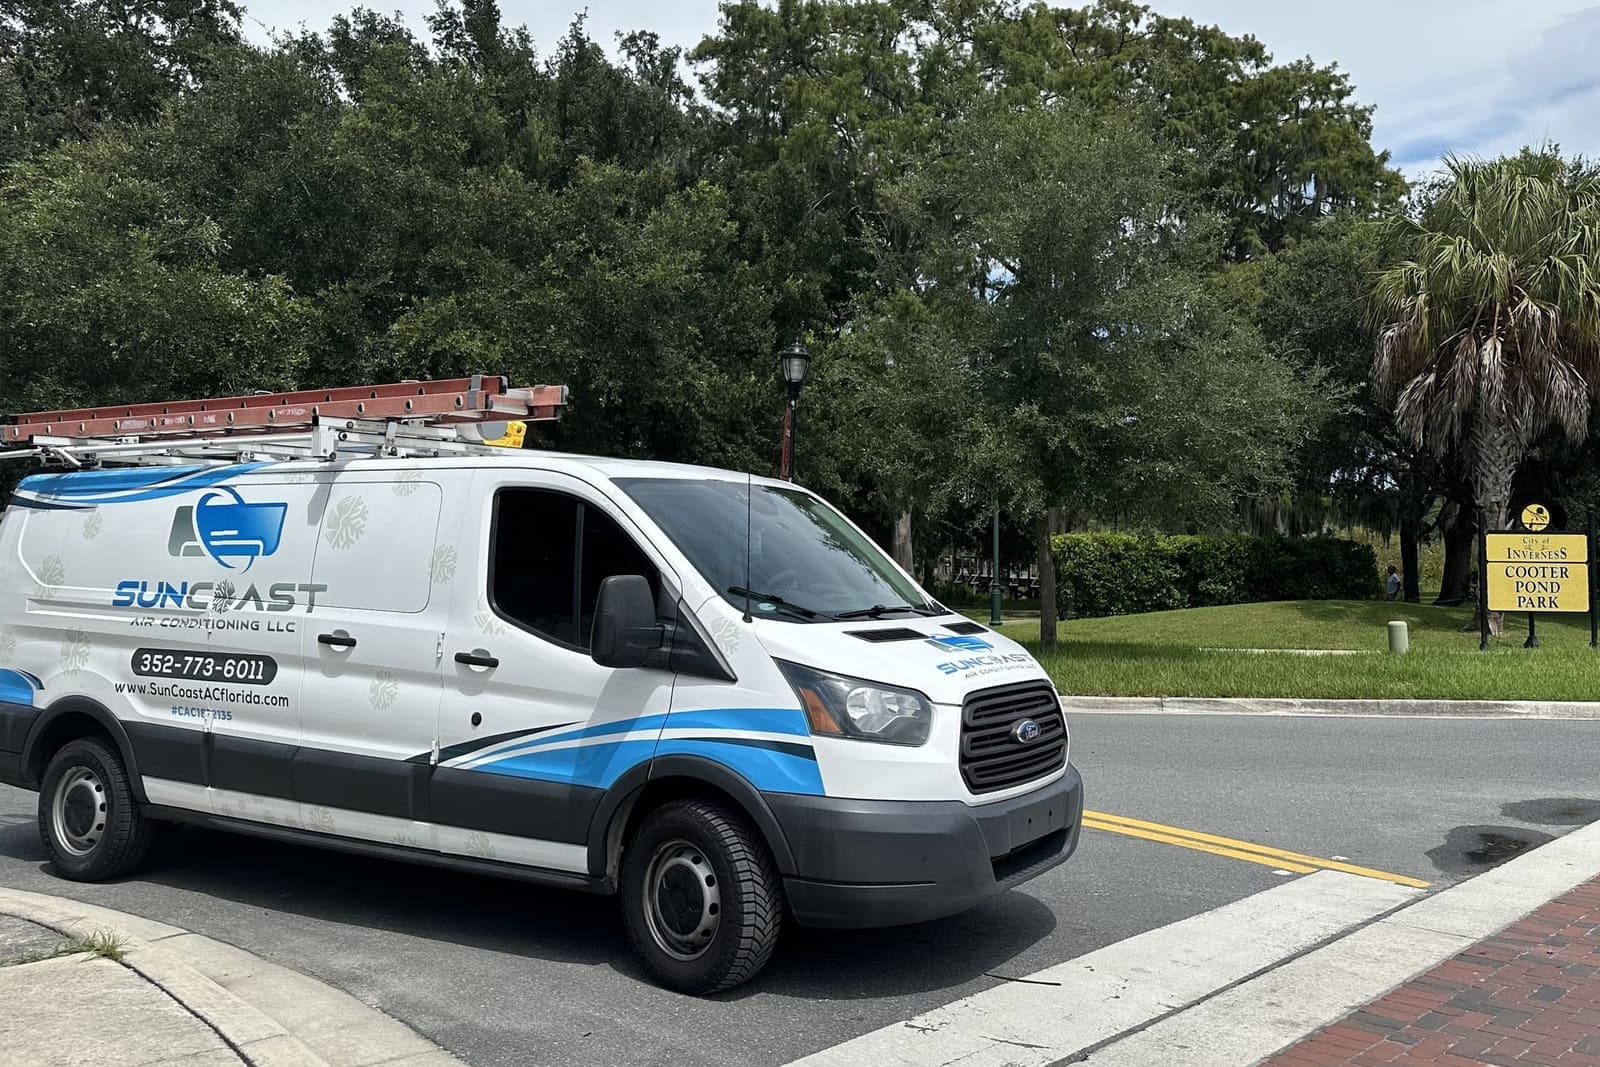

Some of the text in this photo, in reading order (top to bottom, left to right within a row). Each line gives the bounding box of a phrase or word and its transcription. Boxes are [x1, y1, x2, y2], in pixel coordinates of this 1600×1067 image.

[1522, 536, 1550, 545] City of
[1507, 547, 1567, 560] INVERNESS
[1505, 566, 1569, 579] COOTER
[1515, 581, 1561, 594] POND
[112, 579, 328, 614] SUNCOAST
[1517, 596, 1559, 609] PARK
[130, 616, 296, 633] AIR CONDITIONING LLC
[140, 654, 264, 679] 352-773-6011
[114, 682, 289, 707] www.SunCoastACflorida.com
